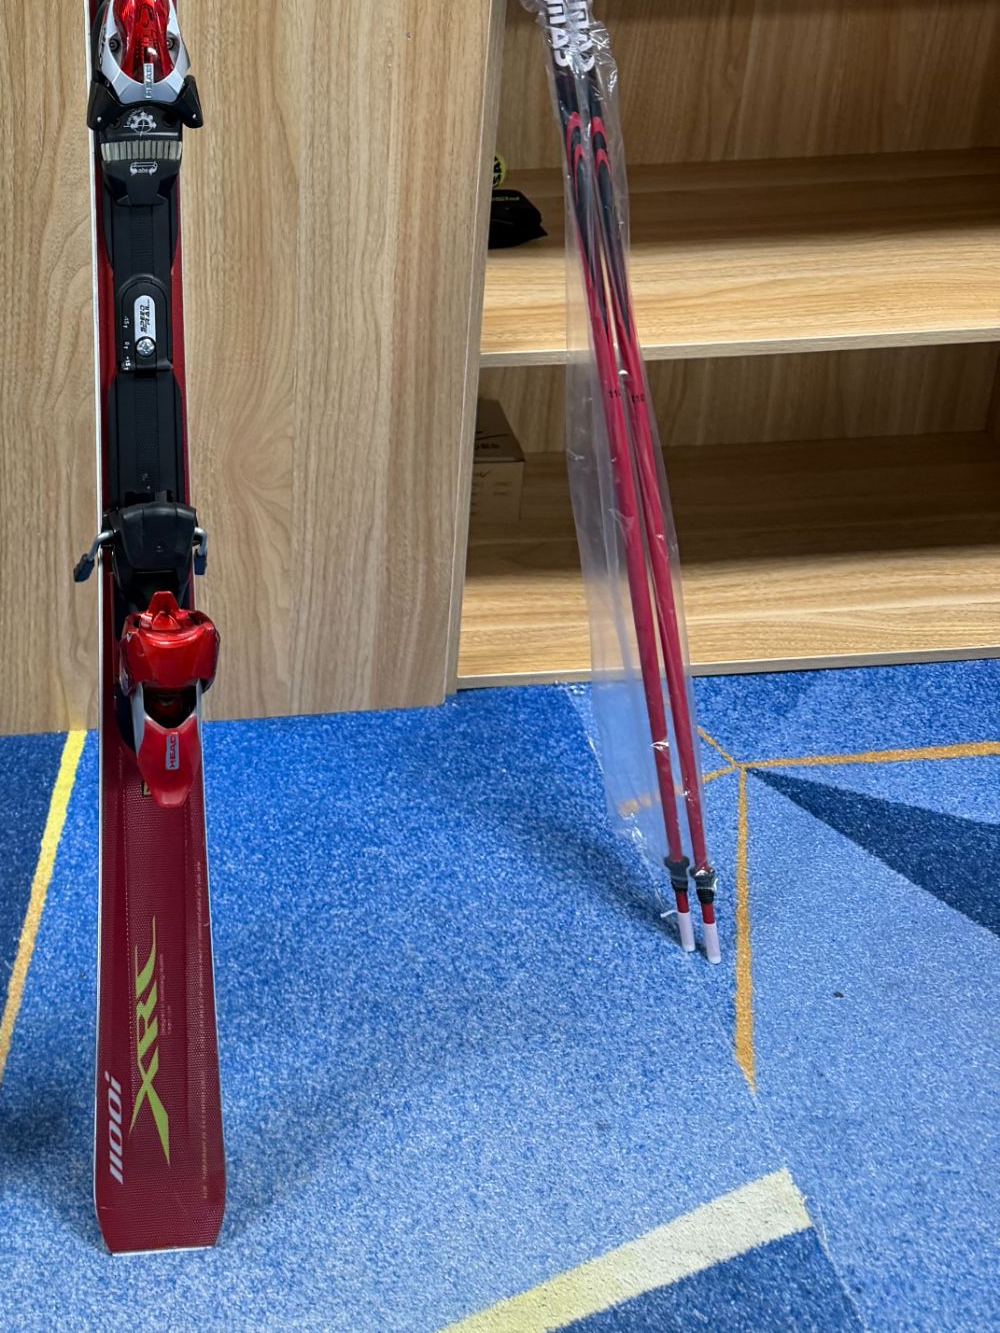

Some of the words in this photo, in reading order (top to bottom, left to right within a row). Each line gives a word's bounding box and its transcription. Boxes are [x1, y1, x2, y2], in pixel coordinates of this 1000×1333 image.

[166, 734, 179, 770] HEAD
[129, 915, 170, 1167] XRC
[105, 1070, 124, 1185] 1100i
